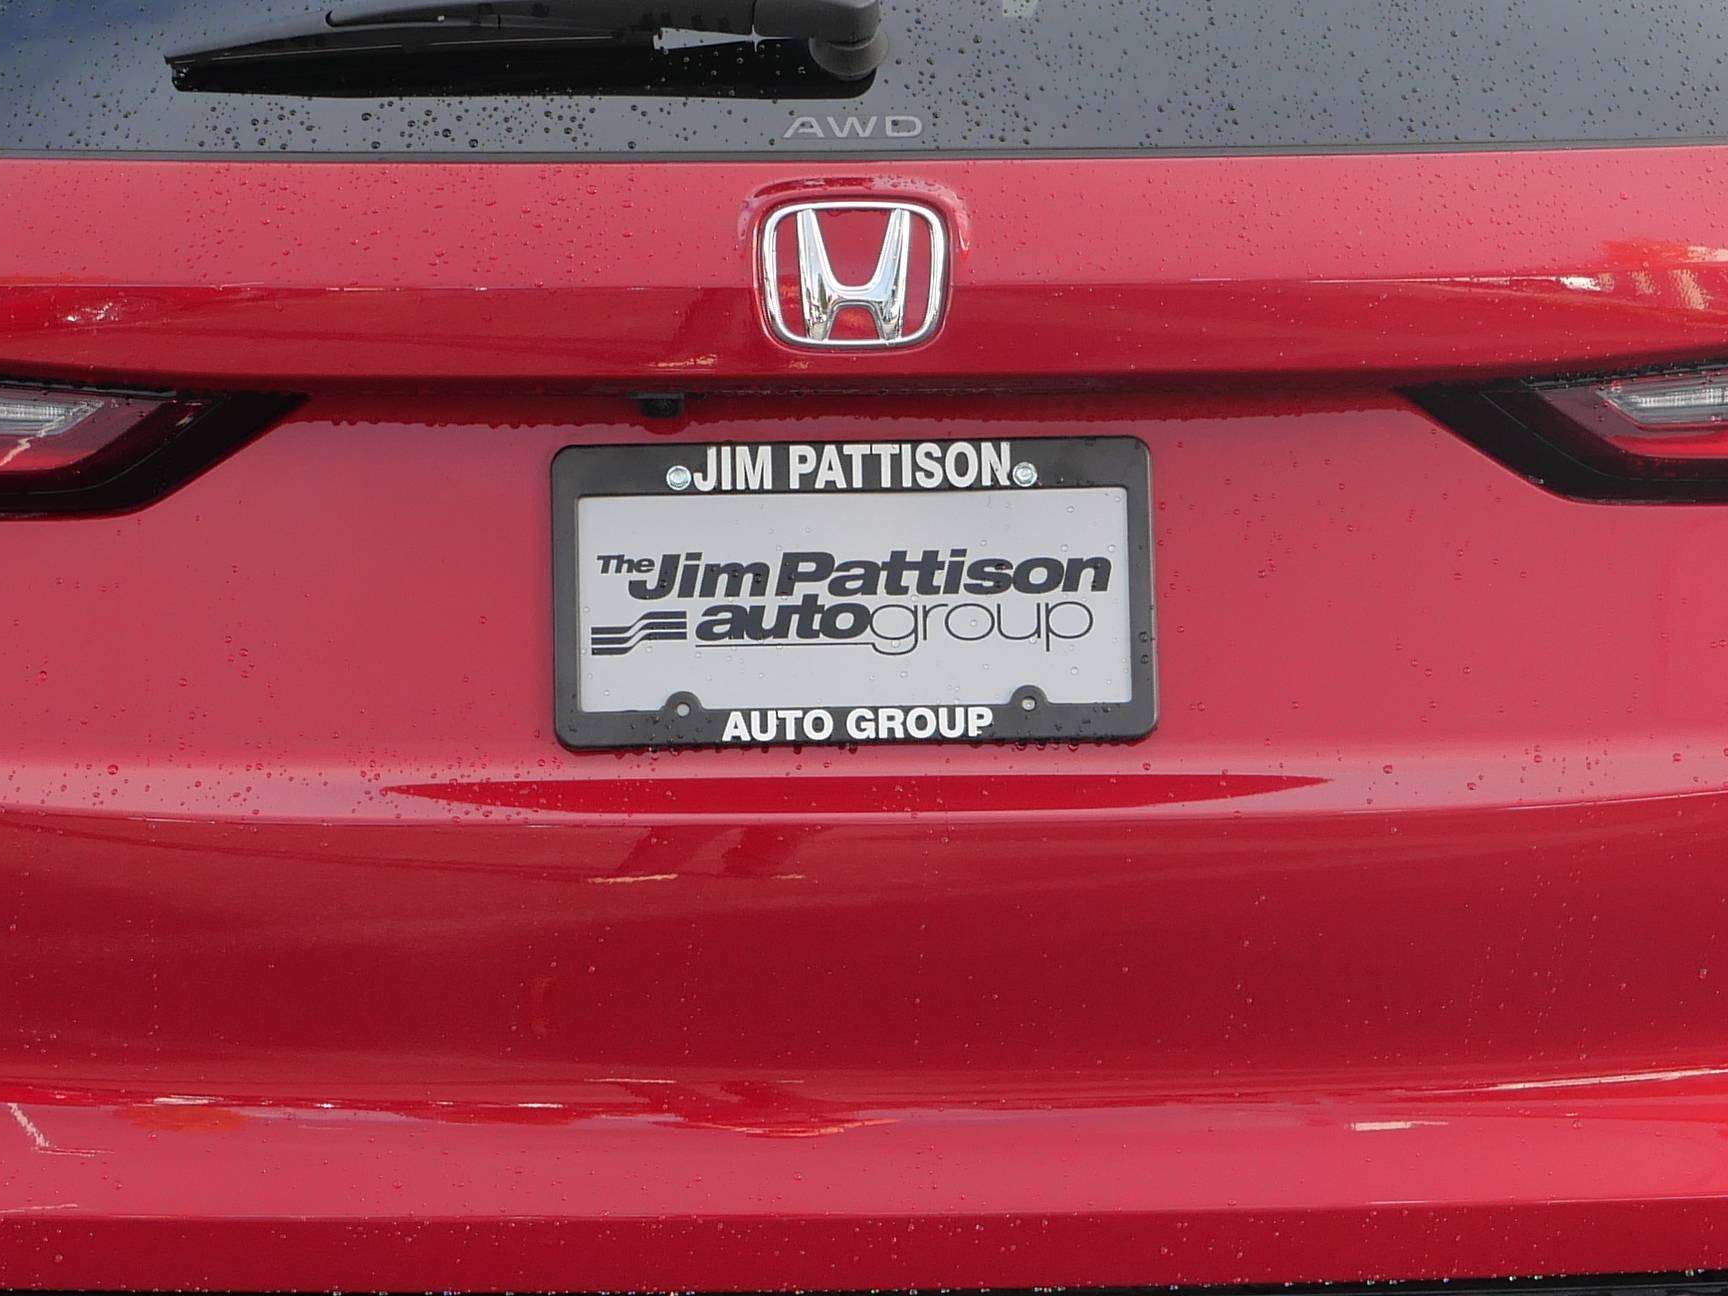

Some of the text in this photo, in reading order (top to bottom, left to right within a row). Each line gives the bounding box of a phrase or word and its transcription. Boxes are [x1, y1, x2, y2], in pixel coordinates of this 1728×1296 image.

[783, 115, 923, 138] AWD
[692, 442, 1011, 491] JIM PATTISON
[597, 555, 655, 576] The
[722, 707, 994, 742] AUTO GROUP
